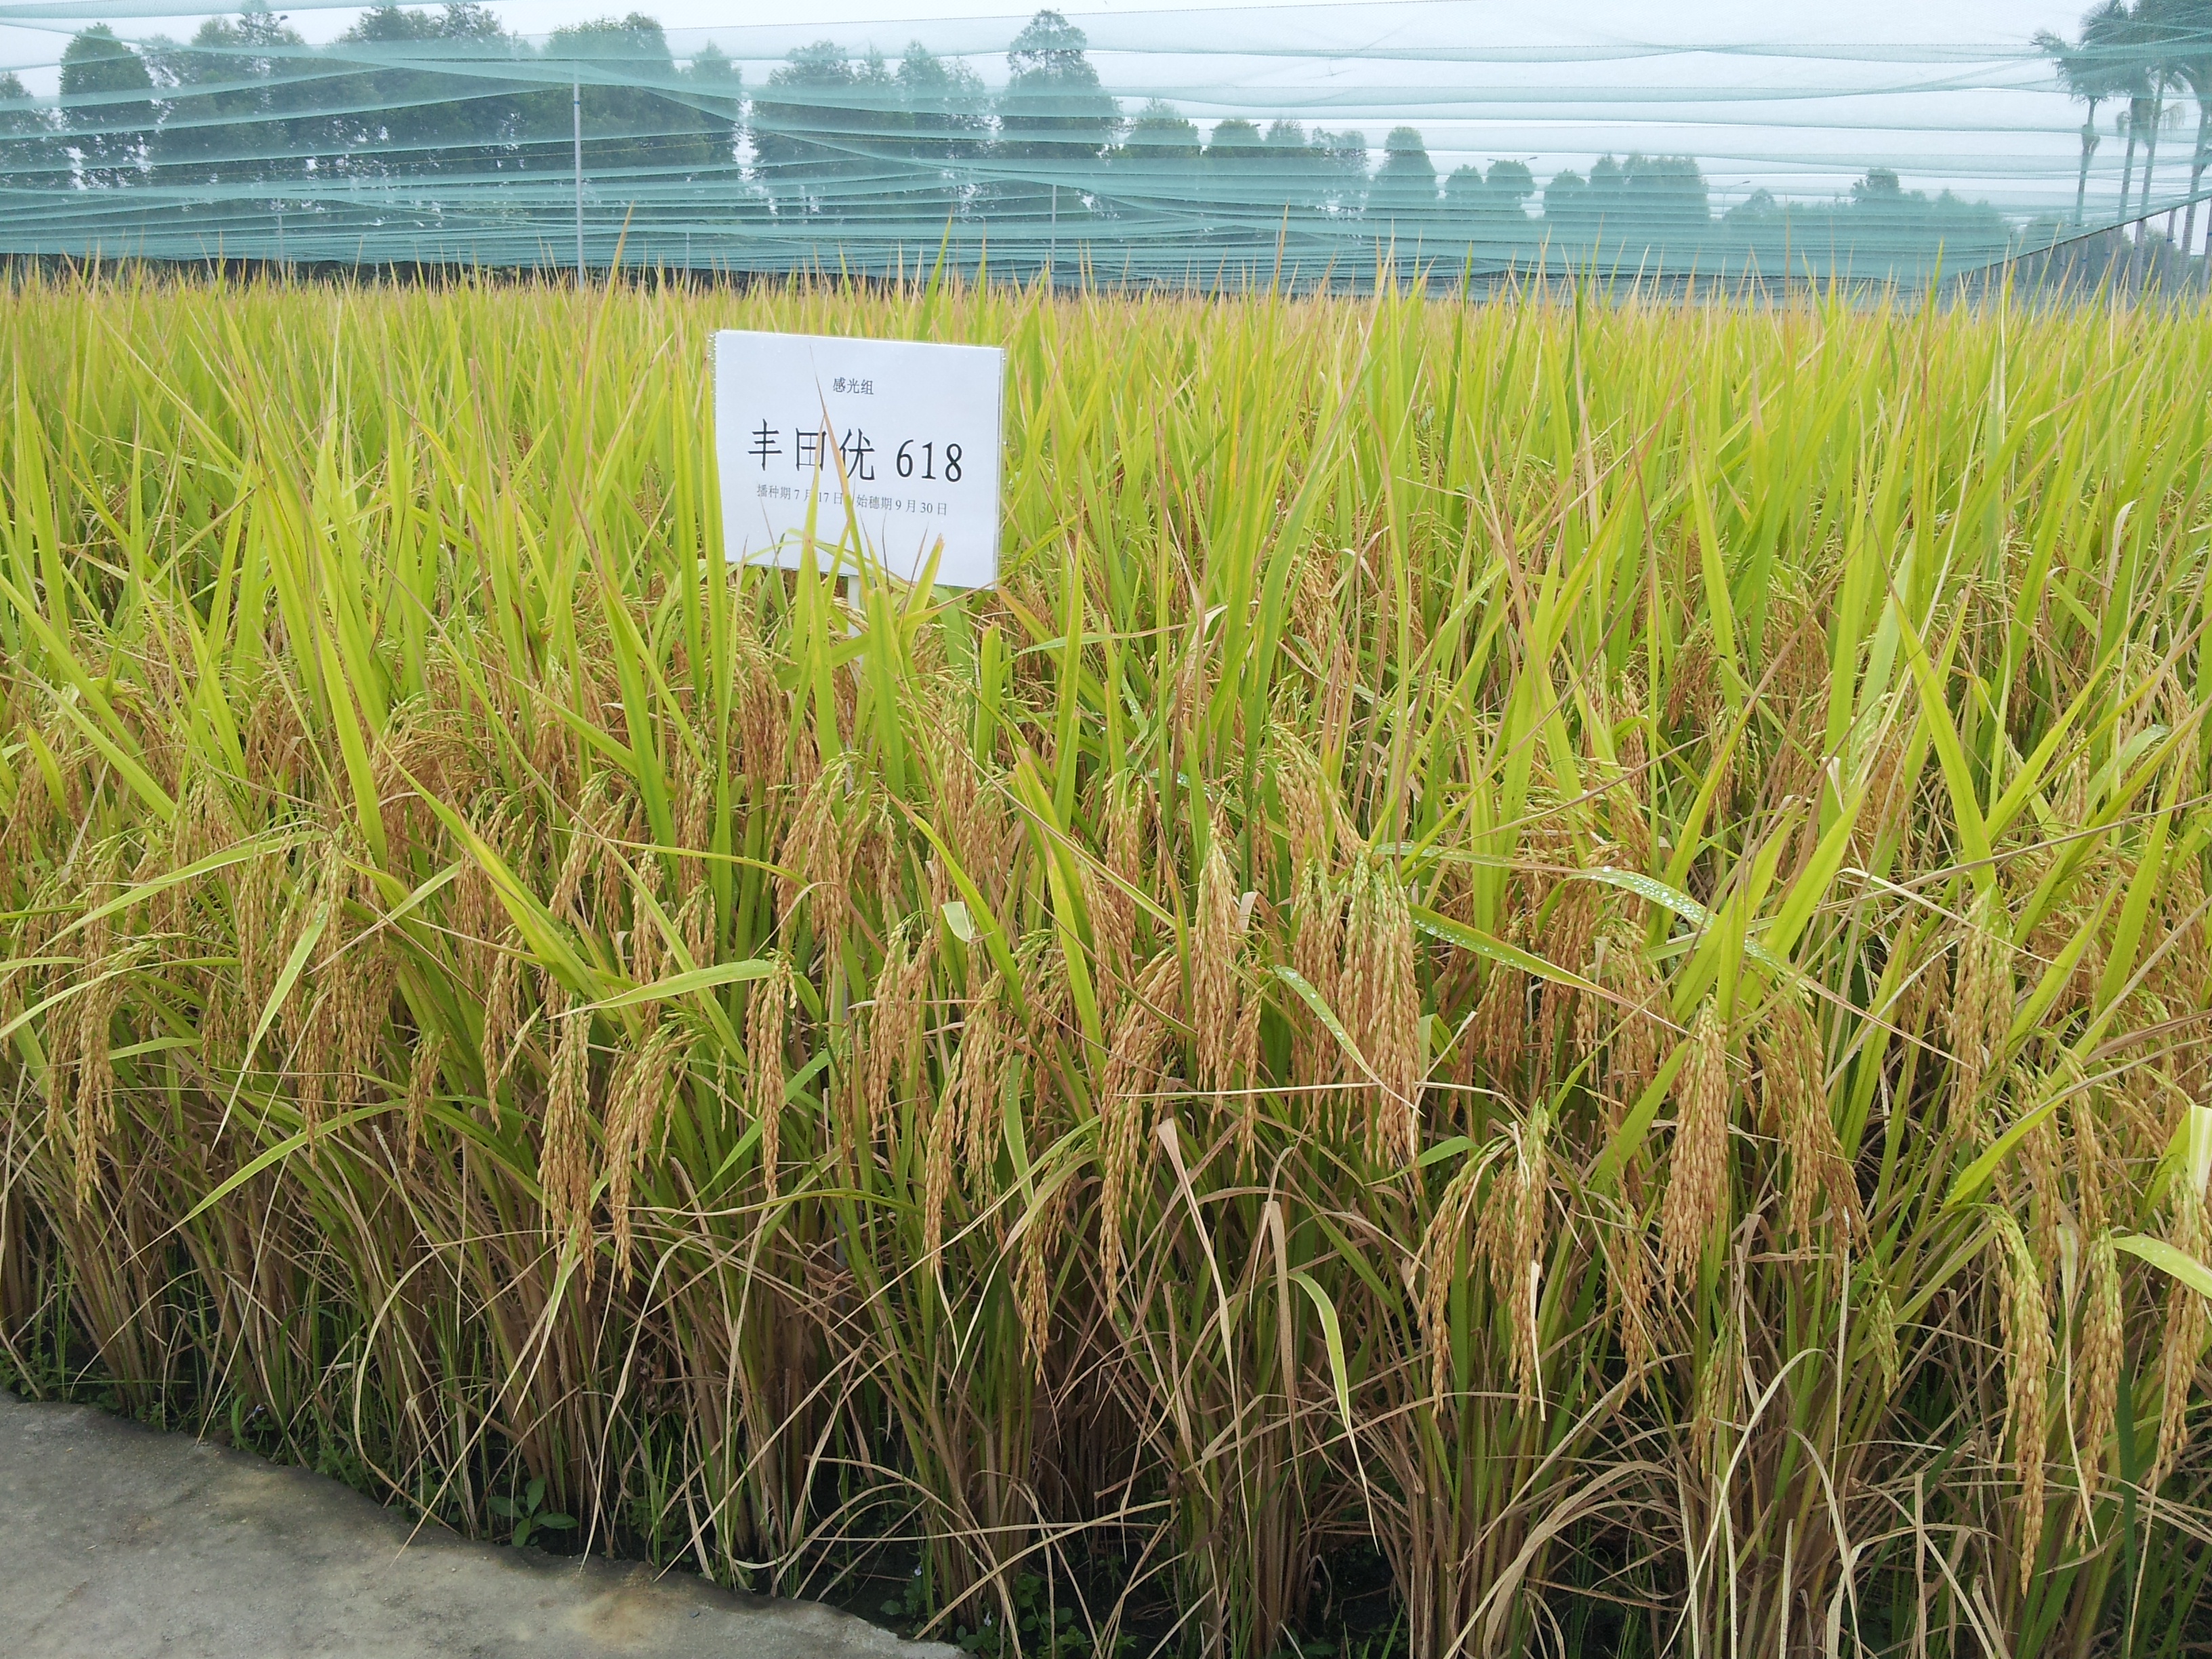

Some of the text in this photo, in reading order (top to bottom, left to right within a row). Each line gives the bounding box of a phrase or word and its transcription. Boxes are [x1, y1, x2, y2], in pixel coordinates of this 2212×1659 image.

[833, 377, 874, 395] 感光组
[747, 418, 963, 483] 丰田优 618
